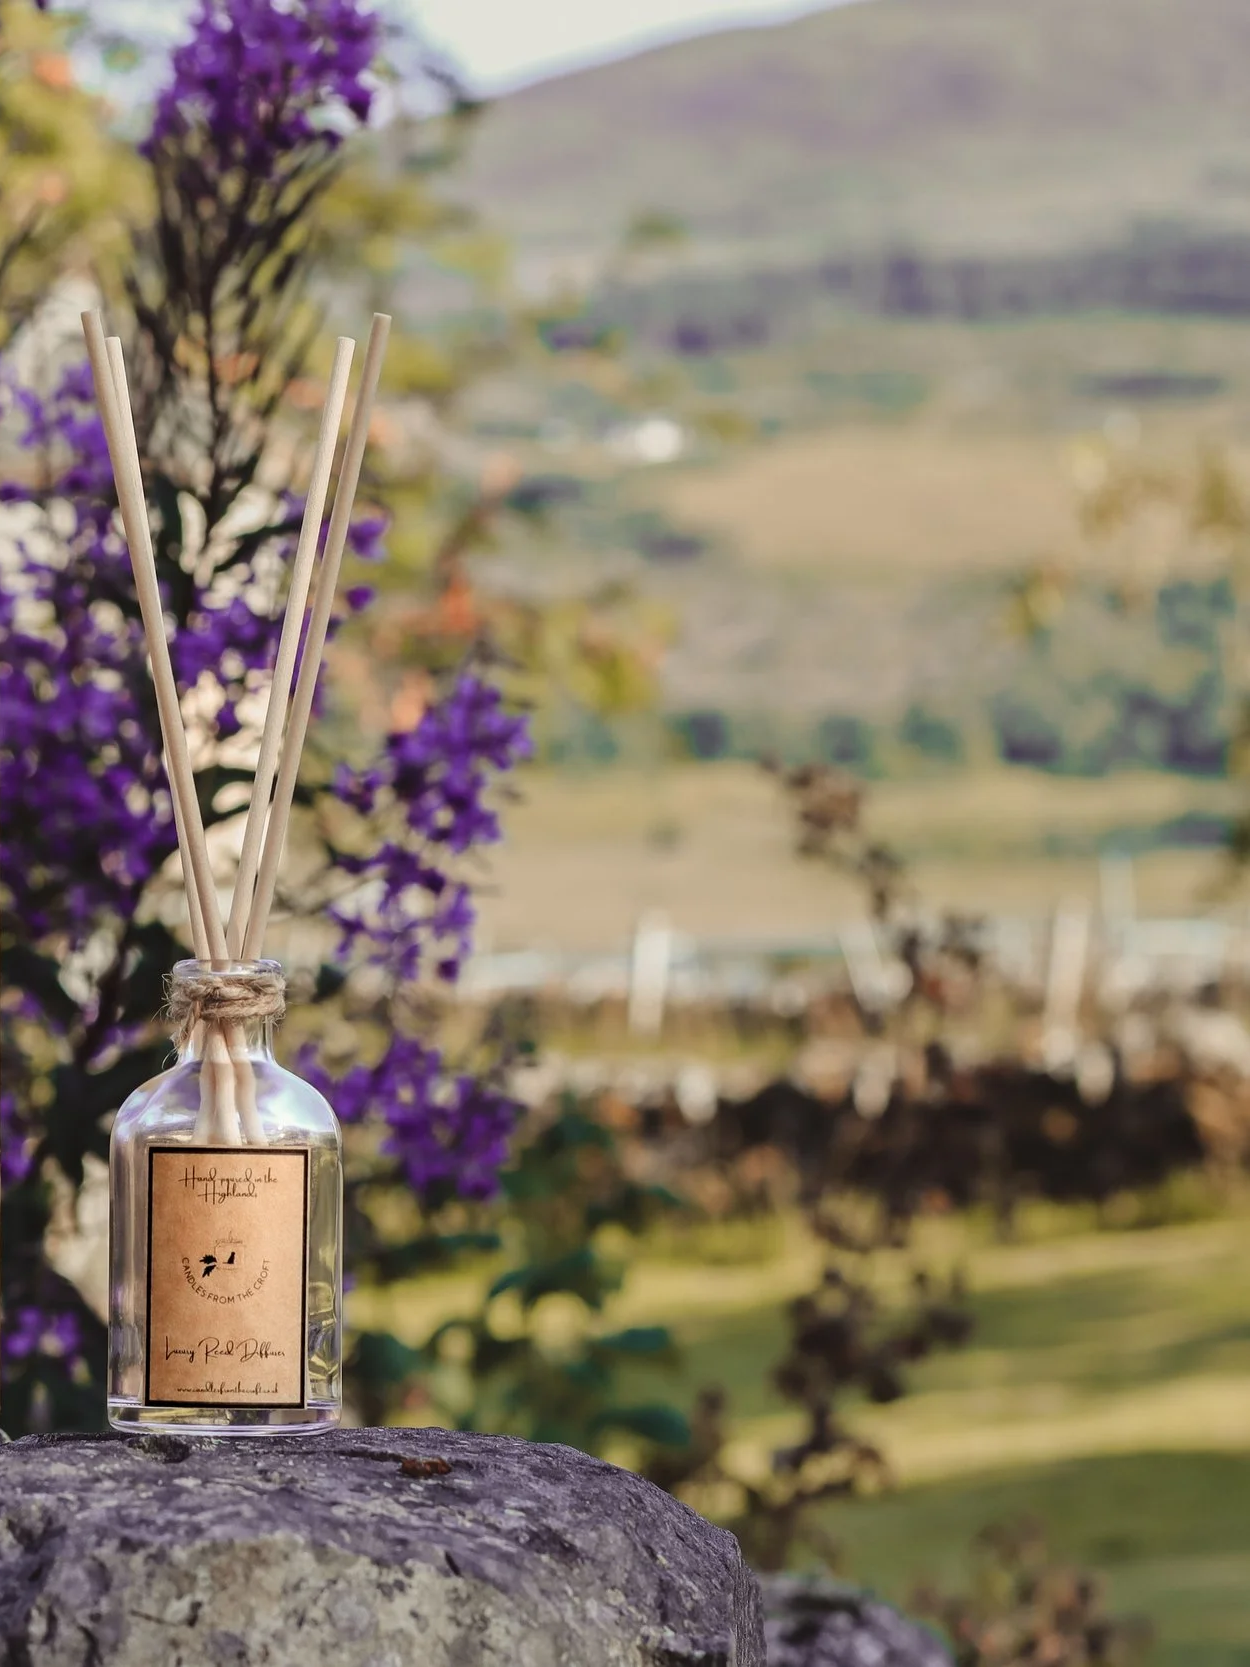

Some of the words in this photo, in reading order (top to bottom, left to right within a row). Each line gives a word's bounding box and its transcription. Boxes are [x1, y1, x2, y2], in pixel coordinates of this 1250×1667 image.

[182, 1257, 207, 1297] CANDLES
[206, 1293, 235, 1304] FROM
[237, 1288, 254, 1301] THE
[253, 1259, 271, 1290] CROFT
[198, 1336, 234, 1364] Reed
